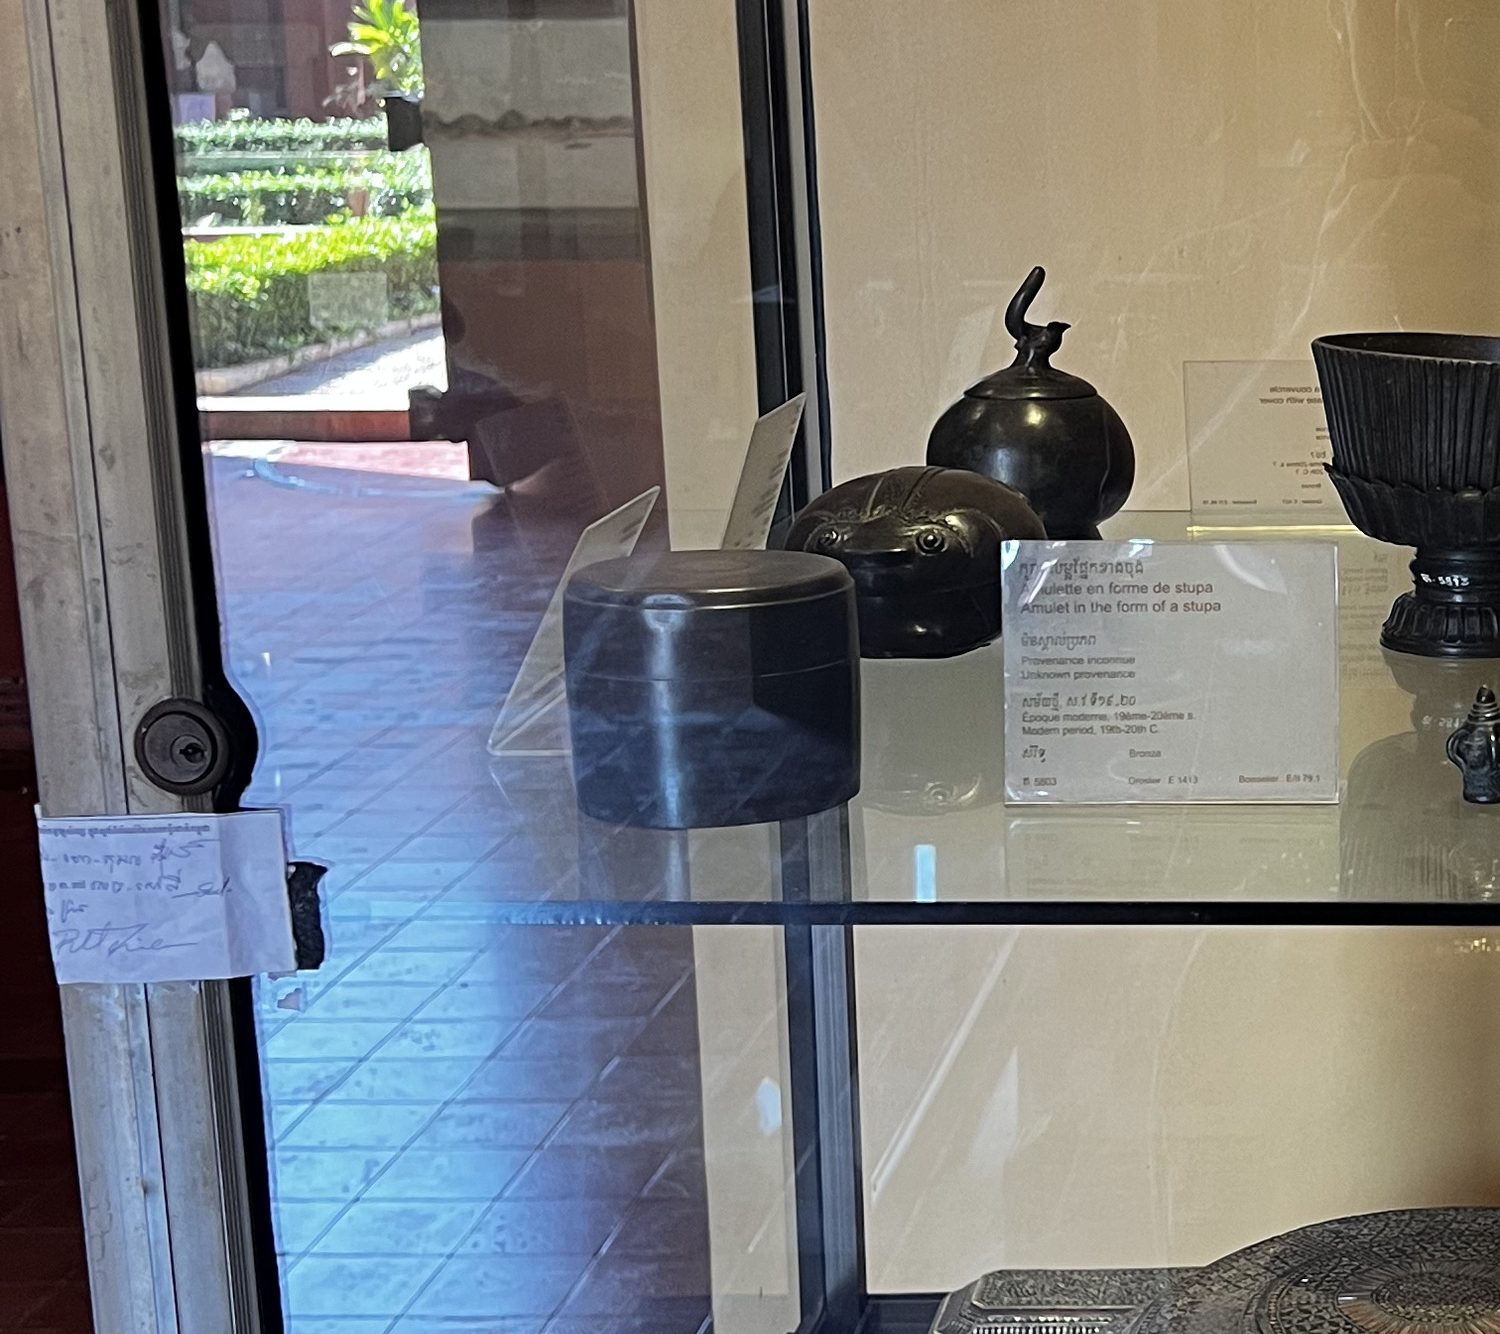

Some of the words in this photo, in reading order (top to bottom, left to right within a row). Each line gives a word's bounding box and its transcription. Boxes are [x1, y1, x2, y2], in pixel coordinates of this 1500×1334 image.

[1086, 584, 1104, 594] en
[1109, 581, 1149, 594] forme
[1153, 581, 1171, 594] de
[1175, 582, 1214, 597] stupa
[1021, 601, 1070, 614] Amulet
[1074, 601, 1086, 614] in
[1091, 600, 1112, 613] the
[1116, 599, 1148, 613] form
[1152, 599, 1168, 613] of
[1169, 602, 1179, 613] a
[1182, 600, 1221, 615] stupa
[1021, 656, 1084, 666] Provenance
[1087, 656, 1136, 665] inconnue
[1021, 670, 1071, 680] Unknown
[1073, 671, 1136, 681] provenance
[1022, 726, 1060, 736] Modern
[1100, 724, 1147, 735] 19th-20th
[1129, 748, 1162, 758] Bronze
